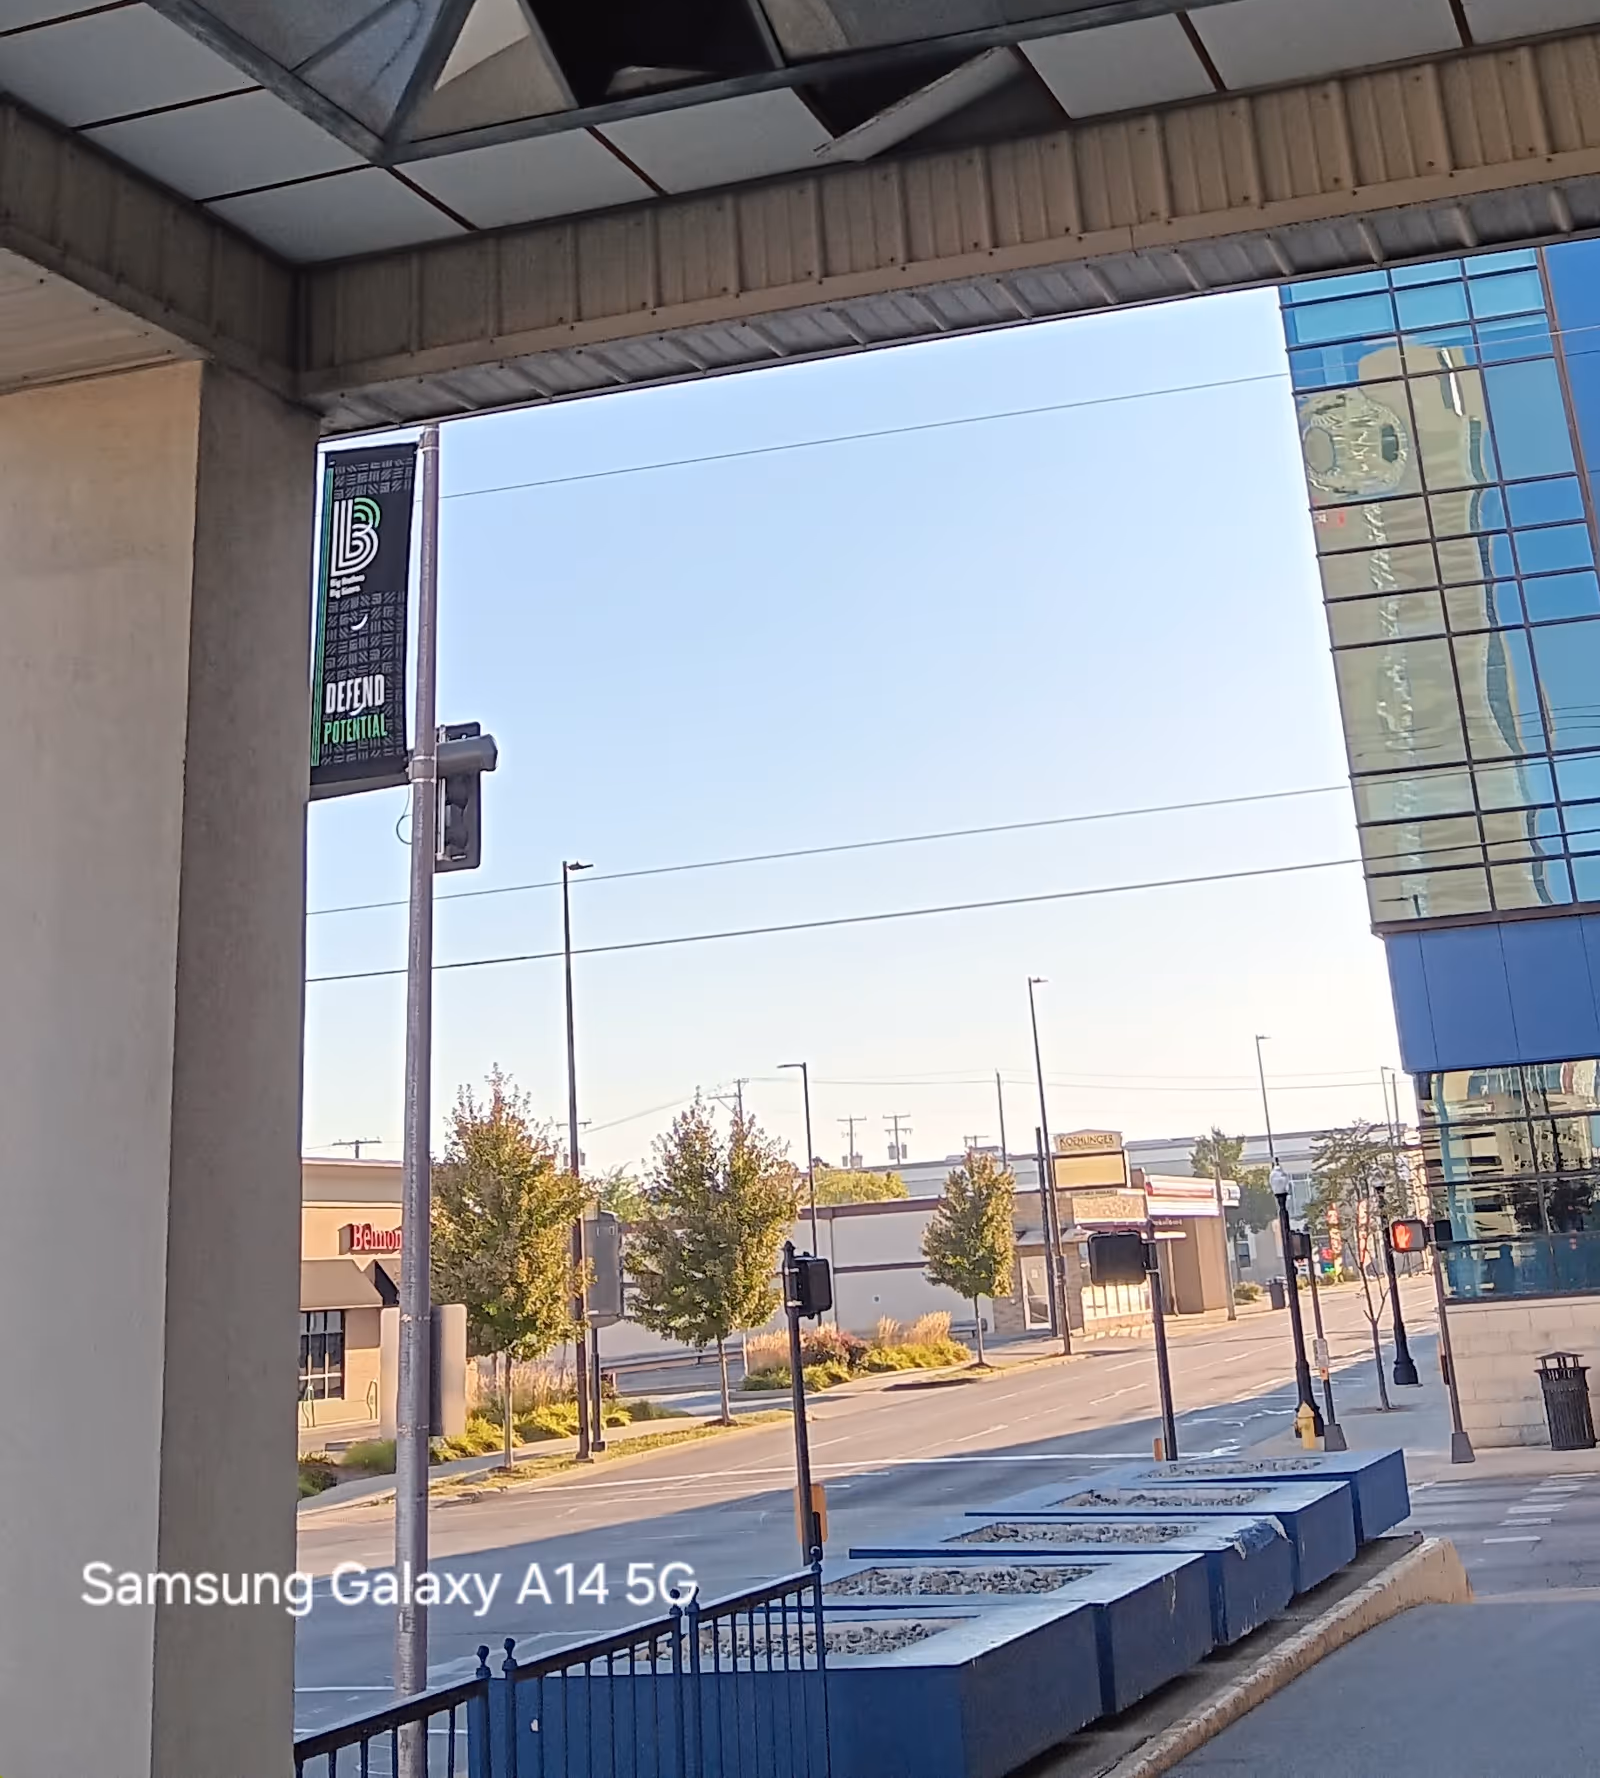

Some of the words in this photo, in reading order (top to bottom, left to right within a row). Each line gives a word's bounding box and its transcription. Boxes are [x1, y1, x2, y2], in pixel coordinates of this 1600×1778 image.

[325, 674, 385, 715] DEFEND
[323, 713, 388, 745] POTENTIAL
[352, 1223, 402, 1251] Belmon
